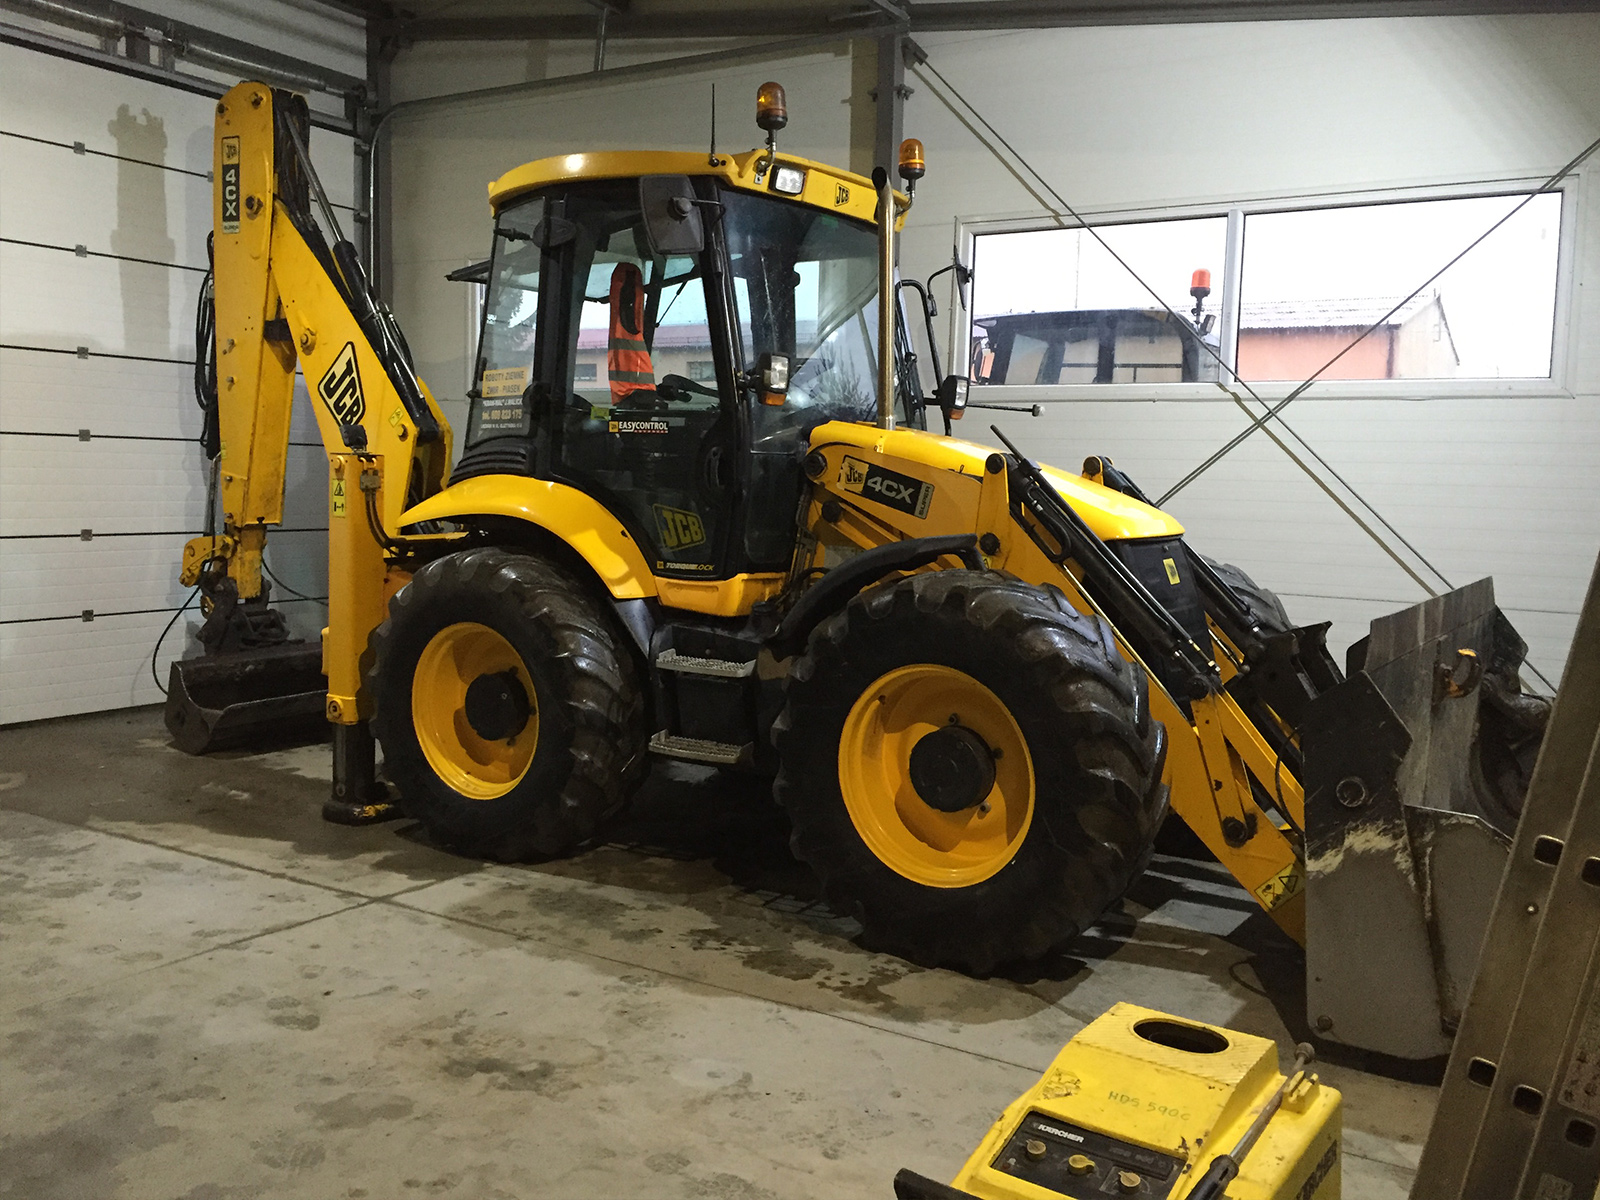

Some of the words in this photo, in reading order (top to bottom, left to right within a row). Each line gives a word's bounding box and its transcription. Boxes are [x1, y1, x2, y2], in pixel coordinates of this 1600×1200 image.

[225, 168, 237, 217] 4CX
[836, 186, 849, 204] JCB
[324, 356, 361, 426] JCB
[618, 421, 668, 432] EASYCONTROL
[846, 465, 864, 483] JCB
[867, 476, 915, 504] 4CX
[662, 508, 702, 547] JCB
[1108, 1090, 1140, 1108] HDS
